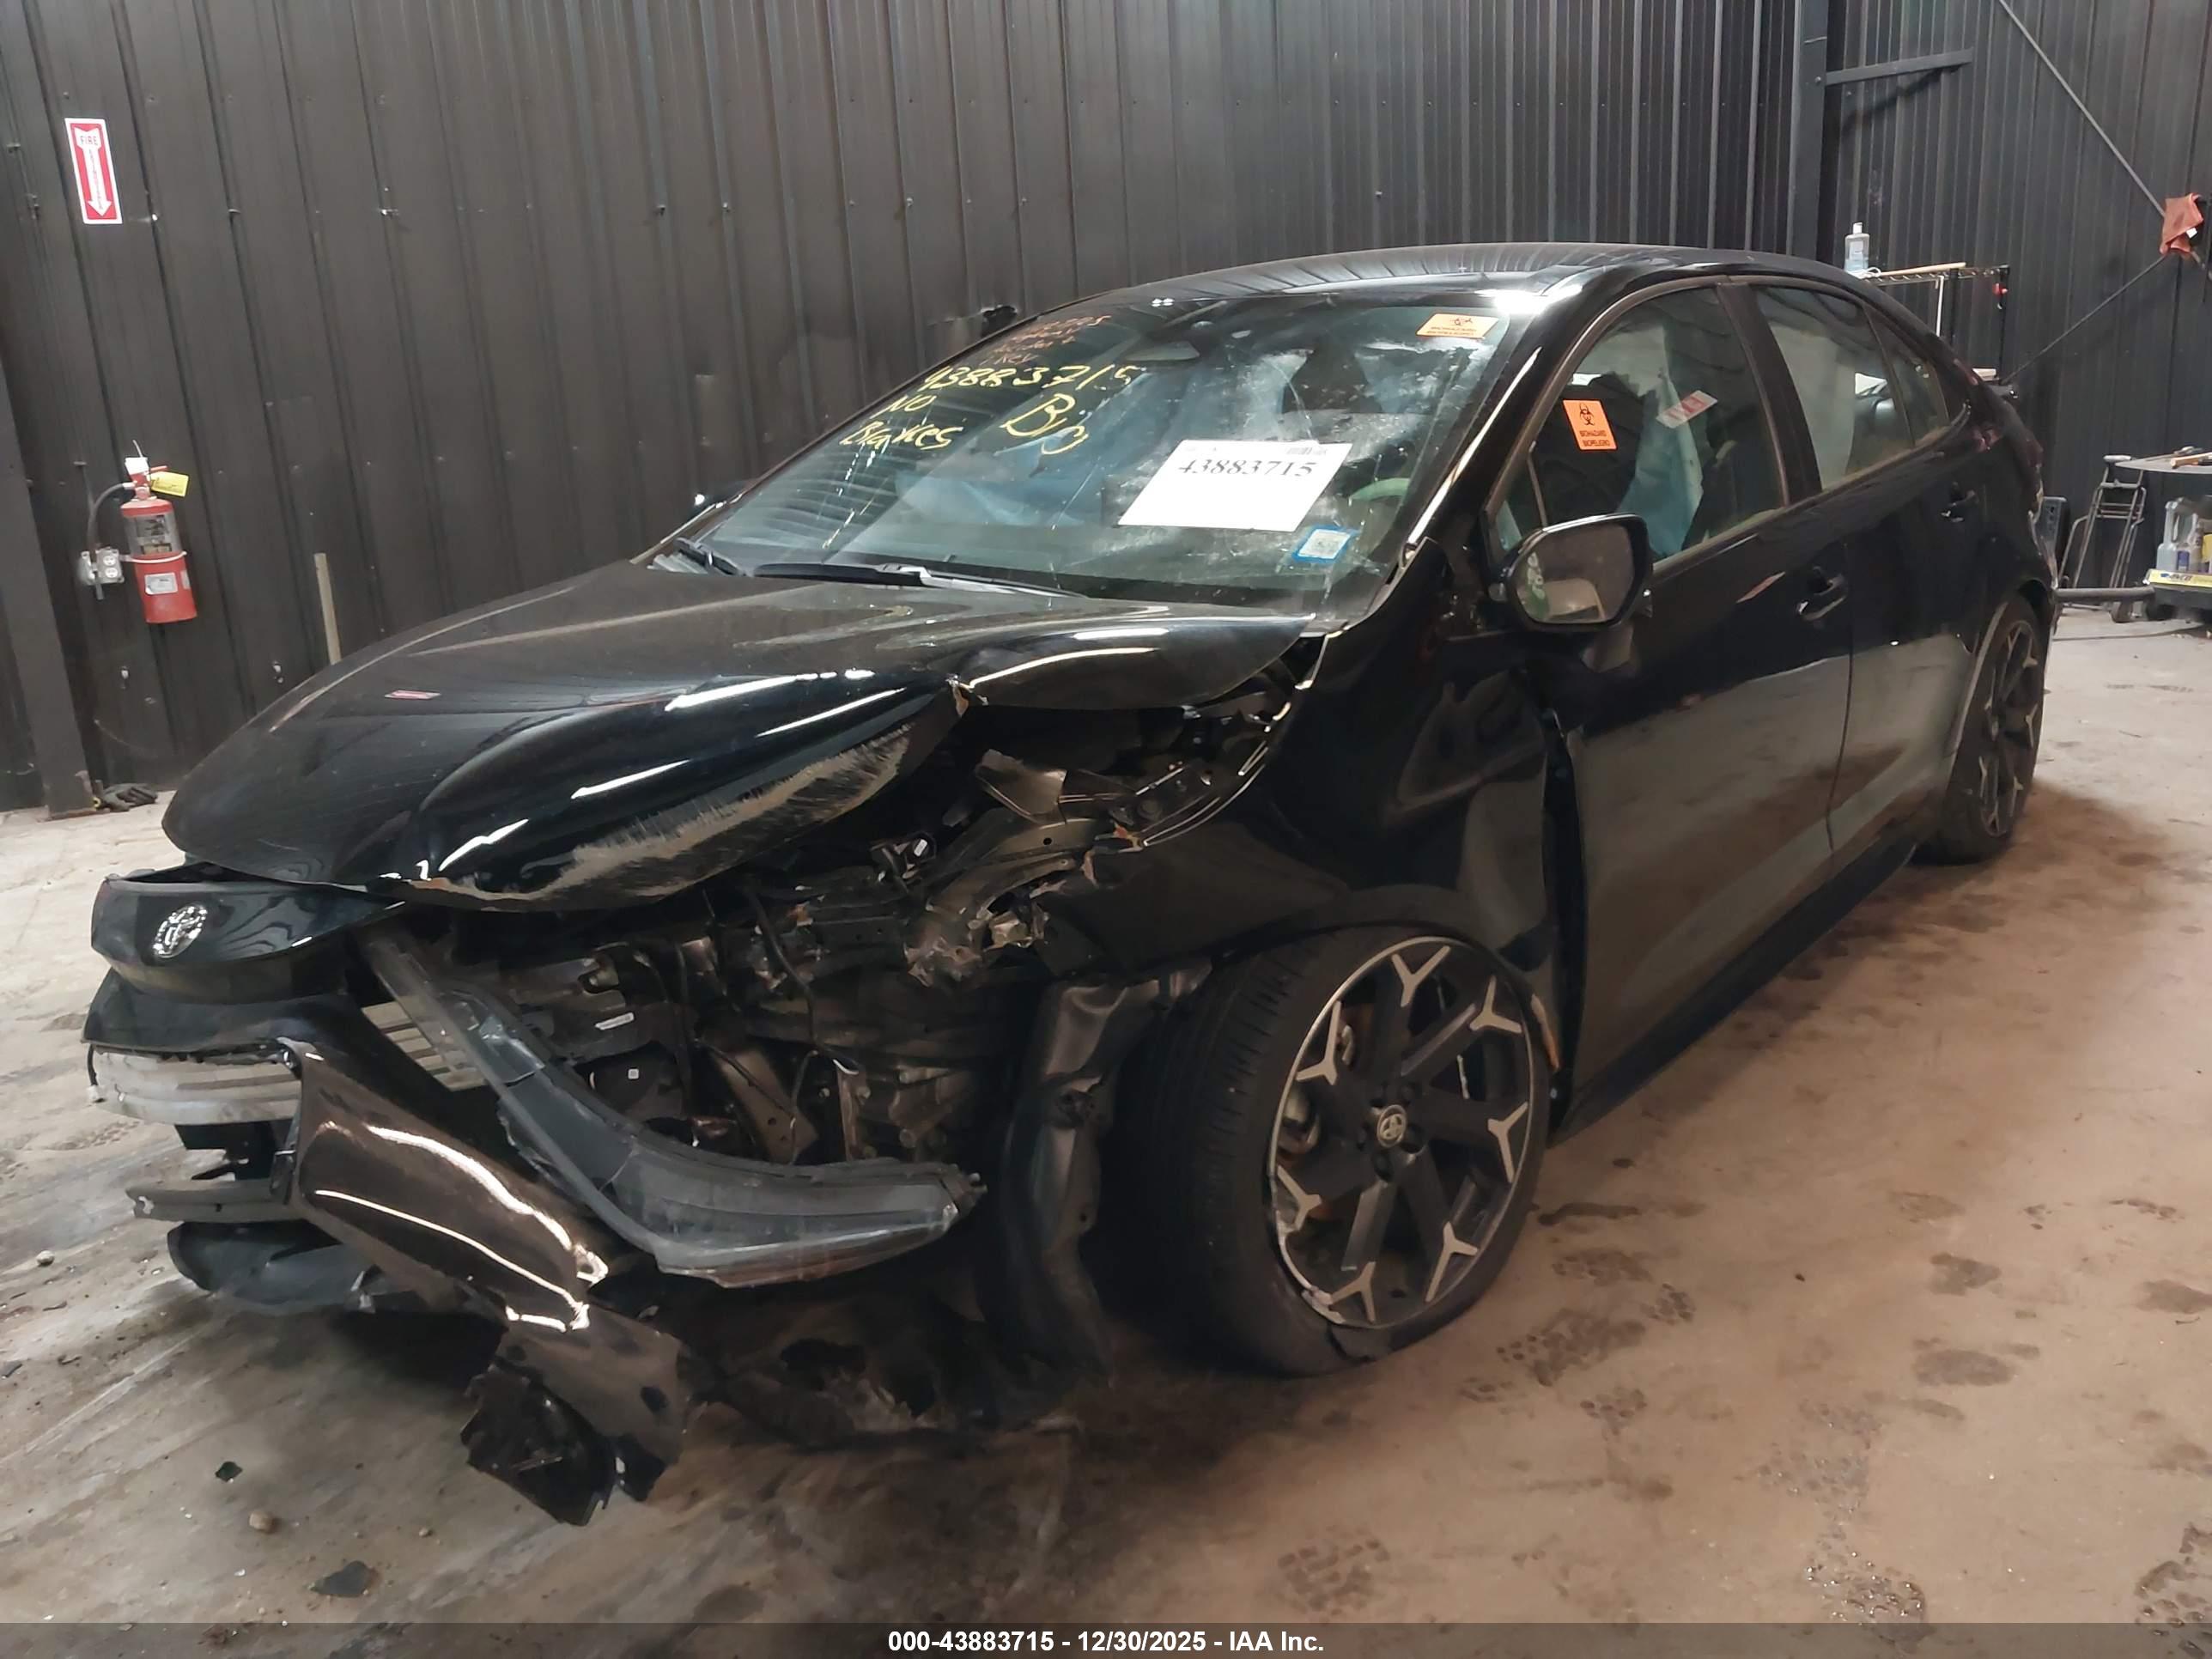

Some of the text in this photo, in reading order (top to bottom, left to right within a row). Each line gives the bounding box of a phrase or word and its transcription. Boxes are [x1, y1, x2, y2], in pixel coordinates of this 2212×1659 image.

[79, 135, 99, 146] FIRE
[918, 364, 1142, 392] 43883715
[870, 394, 937, 419] NO
[1177, 459, 1318, 477] 43883715
